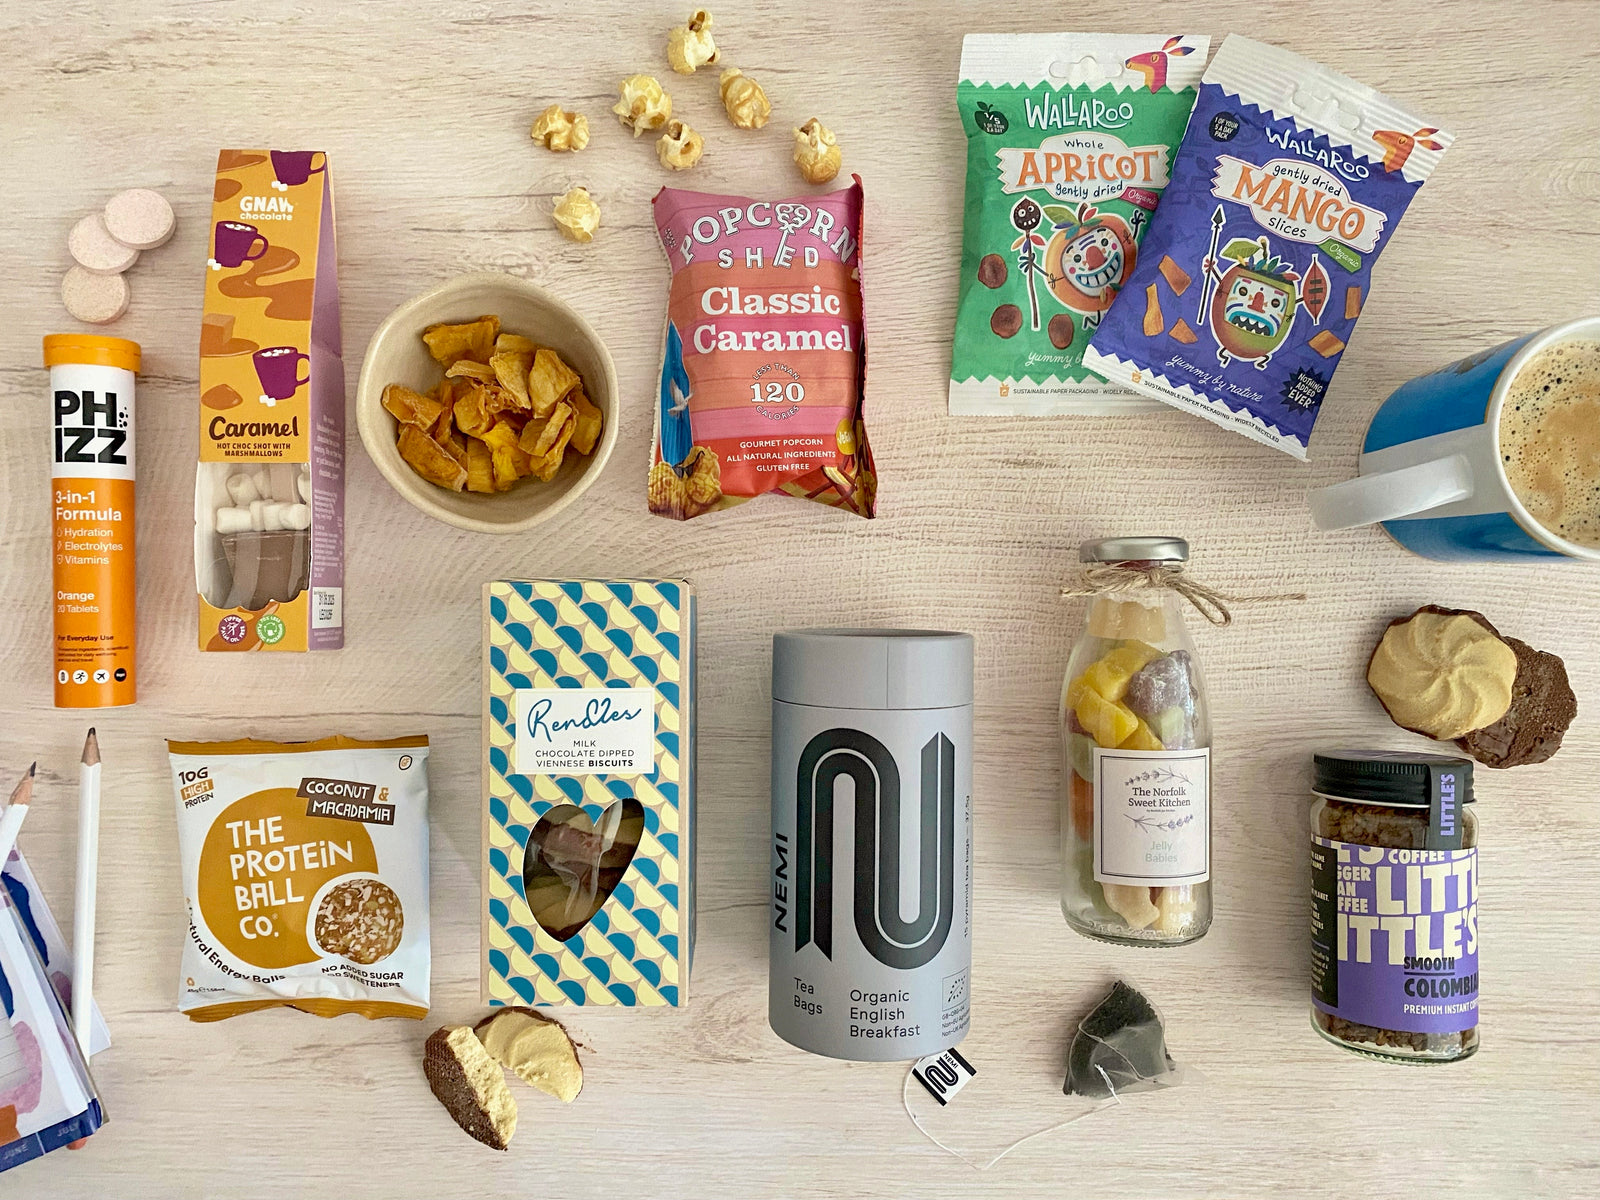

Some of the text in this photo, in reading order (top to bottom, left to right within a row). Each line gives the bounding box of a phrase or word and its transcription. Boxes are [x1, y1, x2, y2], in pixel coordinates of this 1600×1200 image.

[1273, 164, 1342, 197] gently dried
[1055, 180, 1124, 199] gently dried
[239, 196, 295, 213] GNAW
[1231, 165, 1366, 240] MANGO
[239, 212, 293, 221] chocolate
[680, 202, 857, 265] POPCORN
[1268, 216, 1308, 238] slices
[718, 245, 820, 269] SHED
[1328, 243, 1360, 268] Organic
[701, 285, 841, 316] Classic
[693, 324, 853, 355] Caramel
[1074, 351, 1083, 364] b
[752, 363, 800, 381] LESS THAN
[1212, 375, 1229, 391] by
[1295, 381, 1316, 398] ADDED
[1298, 373, 1324, 394] NOTHING
[750, 382, 806, 403] 120
[755, 405, 800, 421] CALORIES
[1144, 380, 1280, 444] SUSTAINABLE PAPER PACKAGING WIDELY RECYCLED
[208, 415, 300, 441] Caramel
[216, 442, 231, 450] HOT
[232, 442, 251, 450] CHOC
[739, 438, 824, 449] GOURMET POPCORN
[726, 450, 836, 463] ALL NATURAL INGREDIENTS
[756, 463, 811, 473] GLUTEN FREE
[55, 490, 96, 504] 3-in-1
[55, 507, 122, 521] Formula
[64, 527, 114, 539] Hydration
[64, 541, 123, 553] Electrolytes
[64, 555, 110, 565] Vitamins
[57, 590, 95, 603] Orange
[57, 604, 100, 613] 20 Tablets
[527, 697, 642, 743] Rendles
[573, 740, 597, 748] MILK
[535, 749, 635, 758] CHOCOLATE DIPPED
[536, 759, 634, 768] VIENNESE BISCUITS
[178, 766, 209, 785] 10G
[183, 781, 210, 799] HIGH
[305, 780, 389, 801] COCONUT &
[1132, 786, 1187, 796] The Norfolk
[312, 800, 391, 822] MACADAMIA
[1128, 797, 1191, 808] Sweet Kitchen
[1440, 773, 1455, 836] LITTLE'S
[225, 815, 285, 849] THE
[1150, 841, 1174, 852] Jelly
[1144, 852, 1178, 863] Babies
[1387, 849, 1445, 865] COFFEE
[774, 832, 789, 934] NEMI
[234, 877, 305, 912] BALL
[208, 951, 250, 979] Energy
[252, 975, 286, 984] Balls
[321, 964, 404, 980] NO ADDED SUGAR
[1403, 956, 1455, 971] SMOOTH
[343, 971, 401, 988] SWEETENERS
[793, 977, 815, 995] Tea
[793, 994, 823, 1016] Bags
[850, 989, 910, 1006] Organic
[850, 1007, 906, 1024] English
[1403, 1004, 1443, 1015] PREMIUM
[1444, 1001, 1470, 1014] INSTANT
[850, 1024, 921, 1039] Breakfast
[943, 1053, 959, 1069] NEMI
[57, 1121, 79, 1137] JULY
[3, 1143, 29, 1160] JUNE
